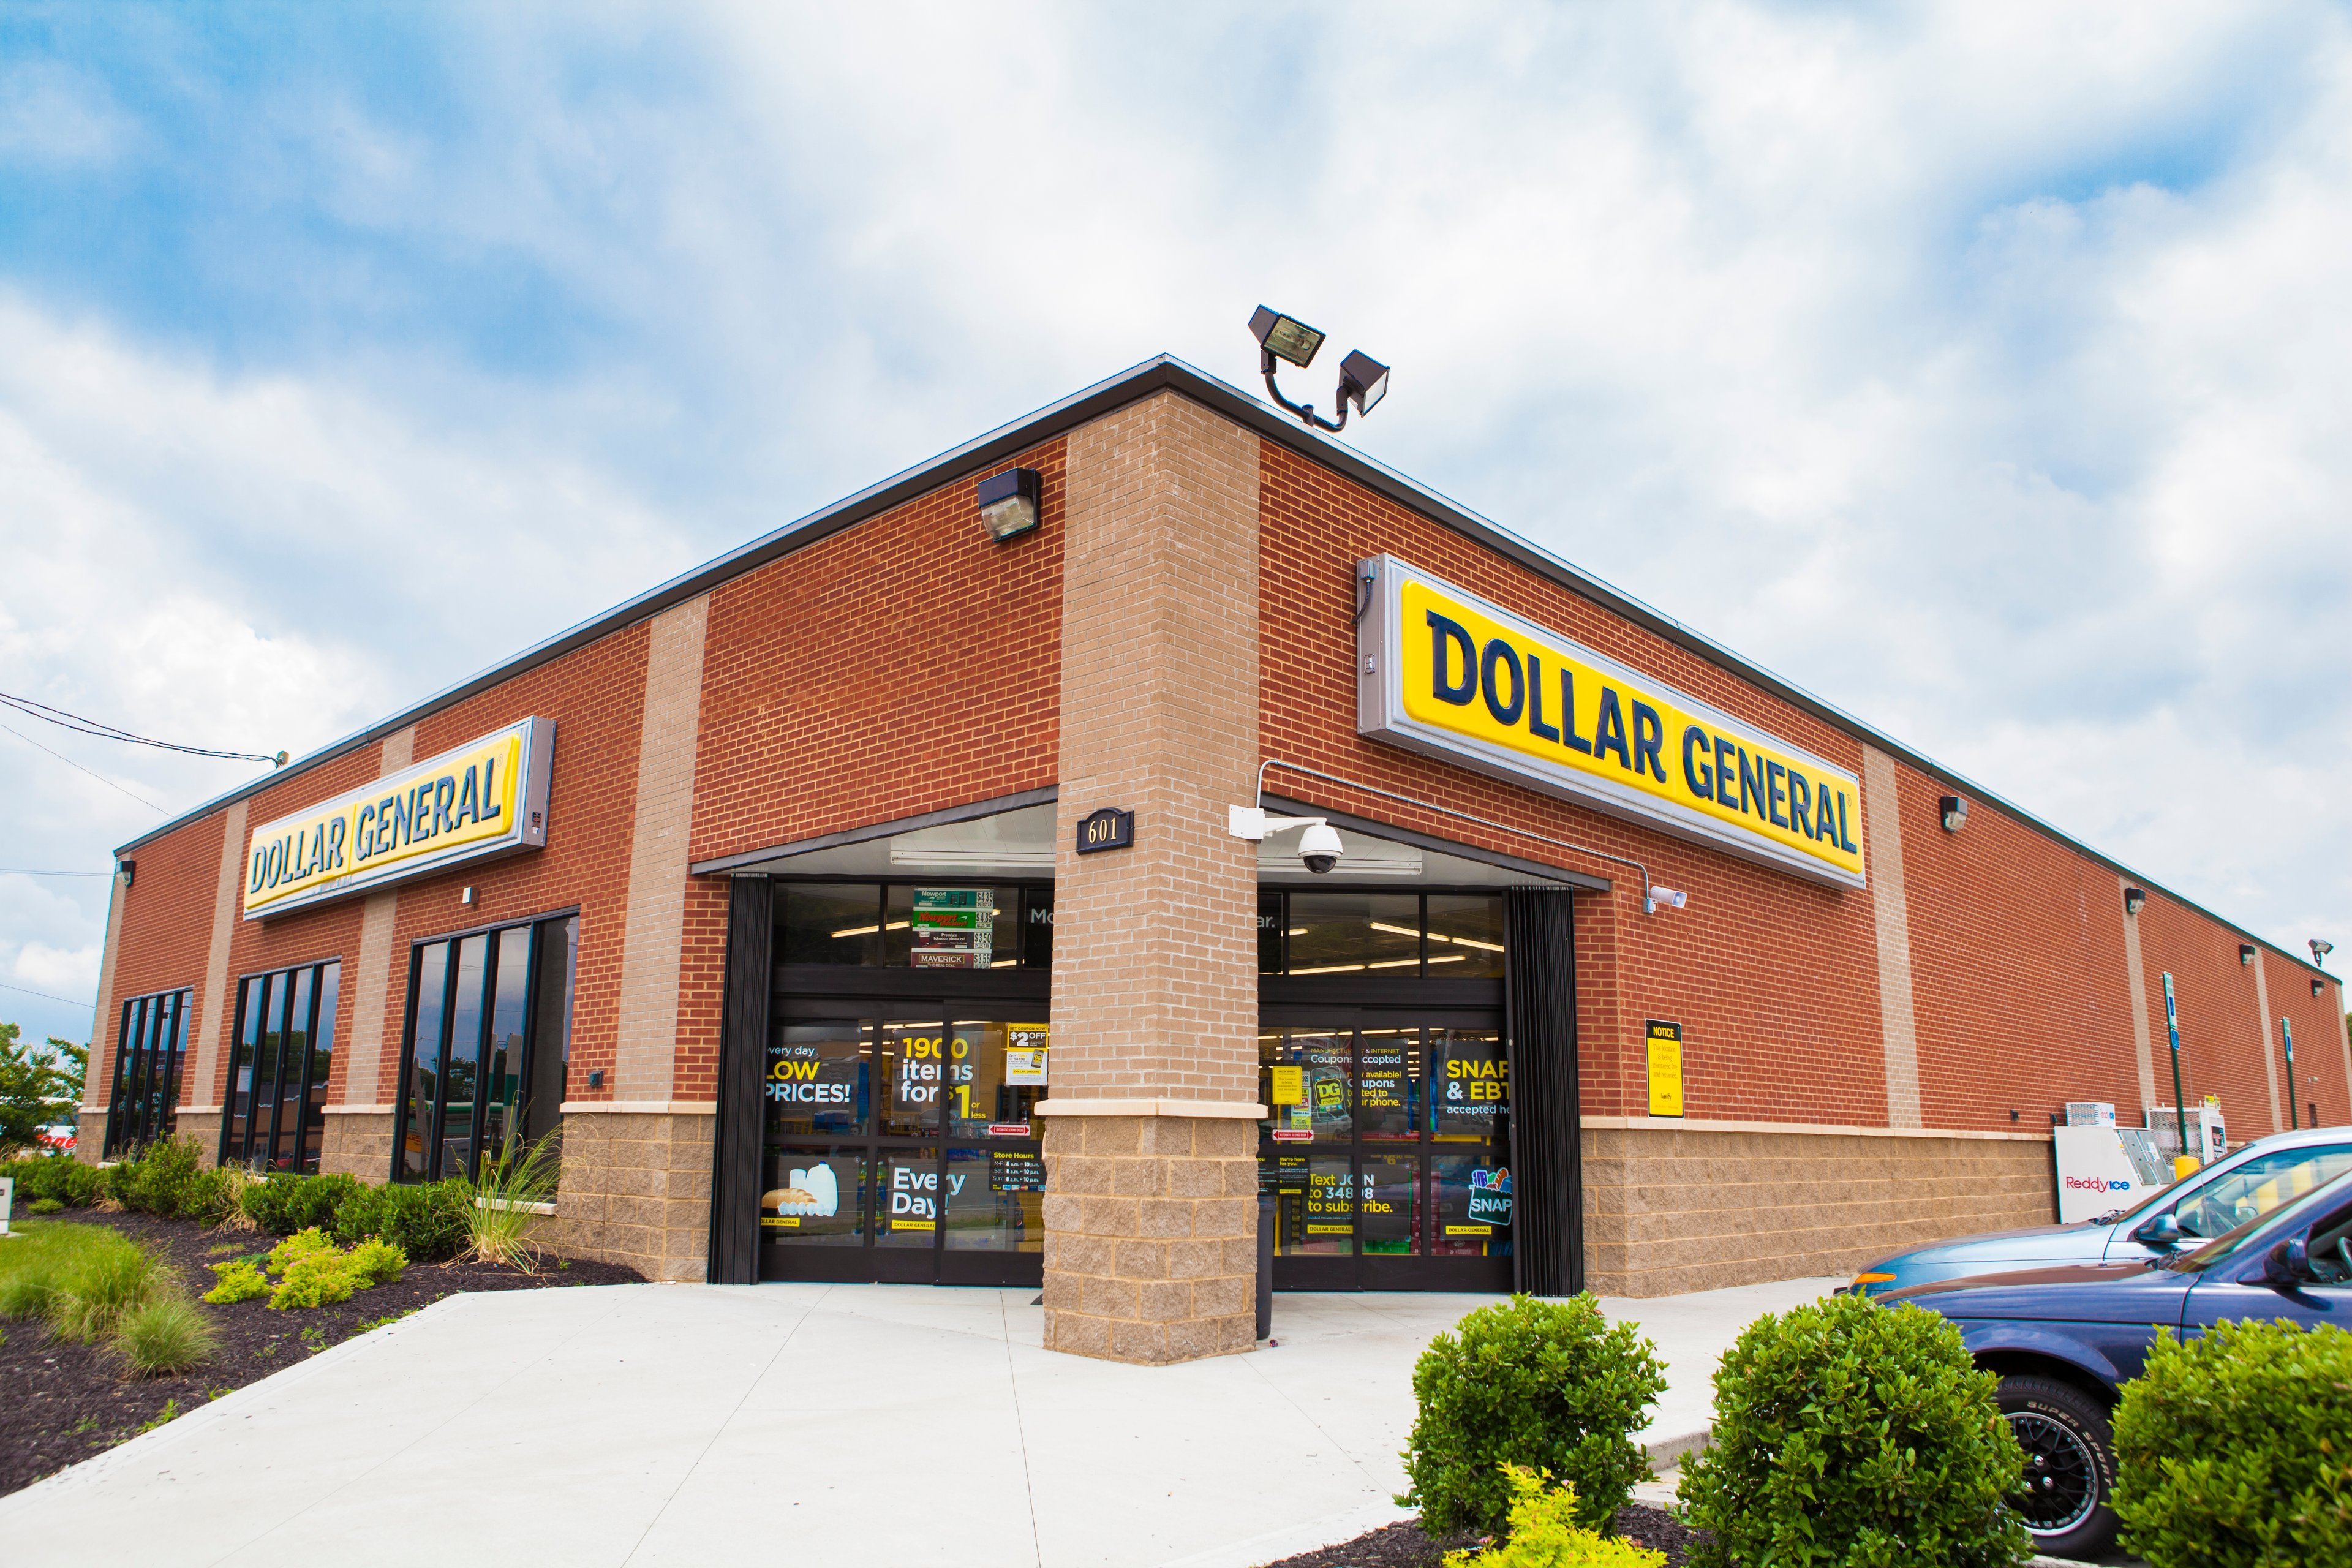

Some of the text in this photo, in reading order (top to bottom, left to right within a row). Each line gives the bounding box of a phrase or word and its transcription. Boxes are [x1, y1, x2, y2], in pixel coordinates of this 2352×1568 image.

[1426, 609, 1858, 855] DOLLAR GENERAL
[250, 758, 501, 894] DOLLAR GENERAL
[1088, 817, 1117, 843] 601
[918, 911, 958, 922] Newport
[1010, 1031, 1029, 1046] $2
[1653, 1026, 1675, 1038] NOTICE
[767, 1046, 815, 1057] very day
[1662, 1044, 1676, 1052] location
[1311, 1054, 1401, 1065] Coupons ccepted
[1366, 1070, 1401, 1079] available!
[1317, 1082, 1341, 1098] DG
[1348, 1079, 1395, 1089] Cupons
[1446, 1081, 1463, 1100] &
[901, 1080, 939, 1102] for
[1370, 1098, 1401, 1107] phone.
[1446, 1105, 1496, 1115] accepted
[1310, 1173, 1336, 1186] Text
[1307, 1200, 1322, 1212] to
[1471, 1199, 1512, 1212] SNAP
[2027, 1401, 2079, 1428] SUPER
[2082, 1431, 2113, 1487] SPORT
